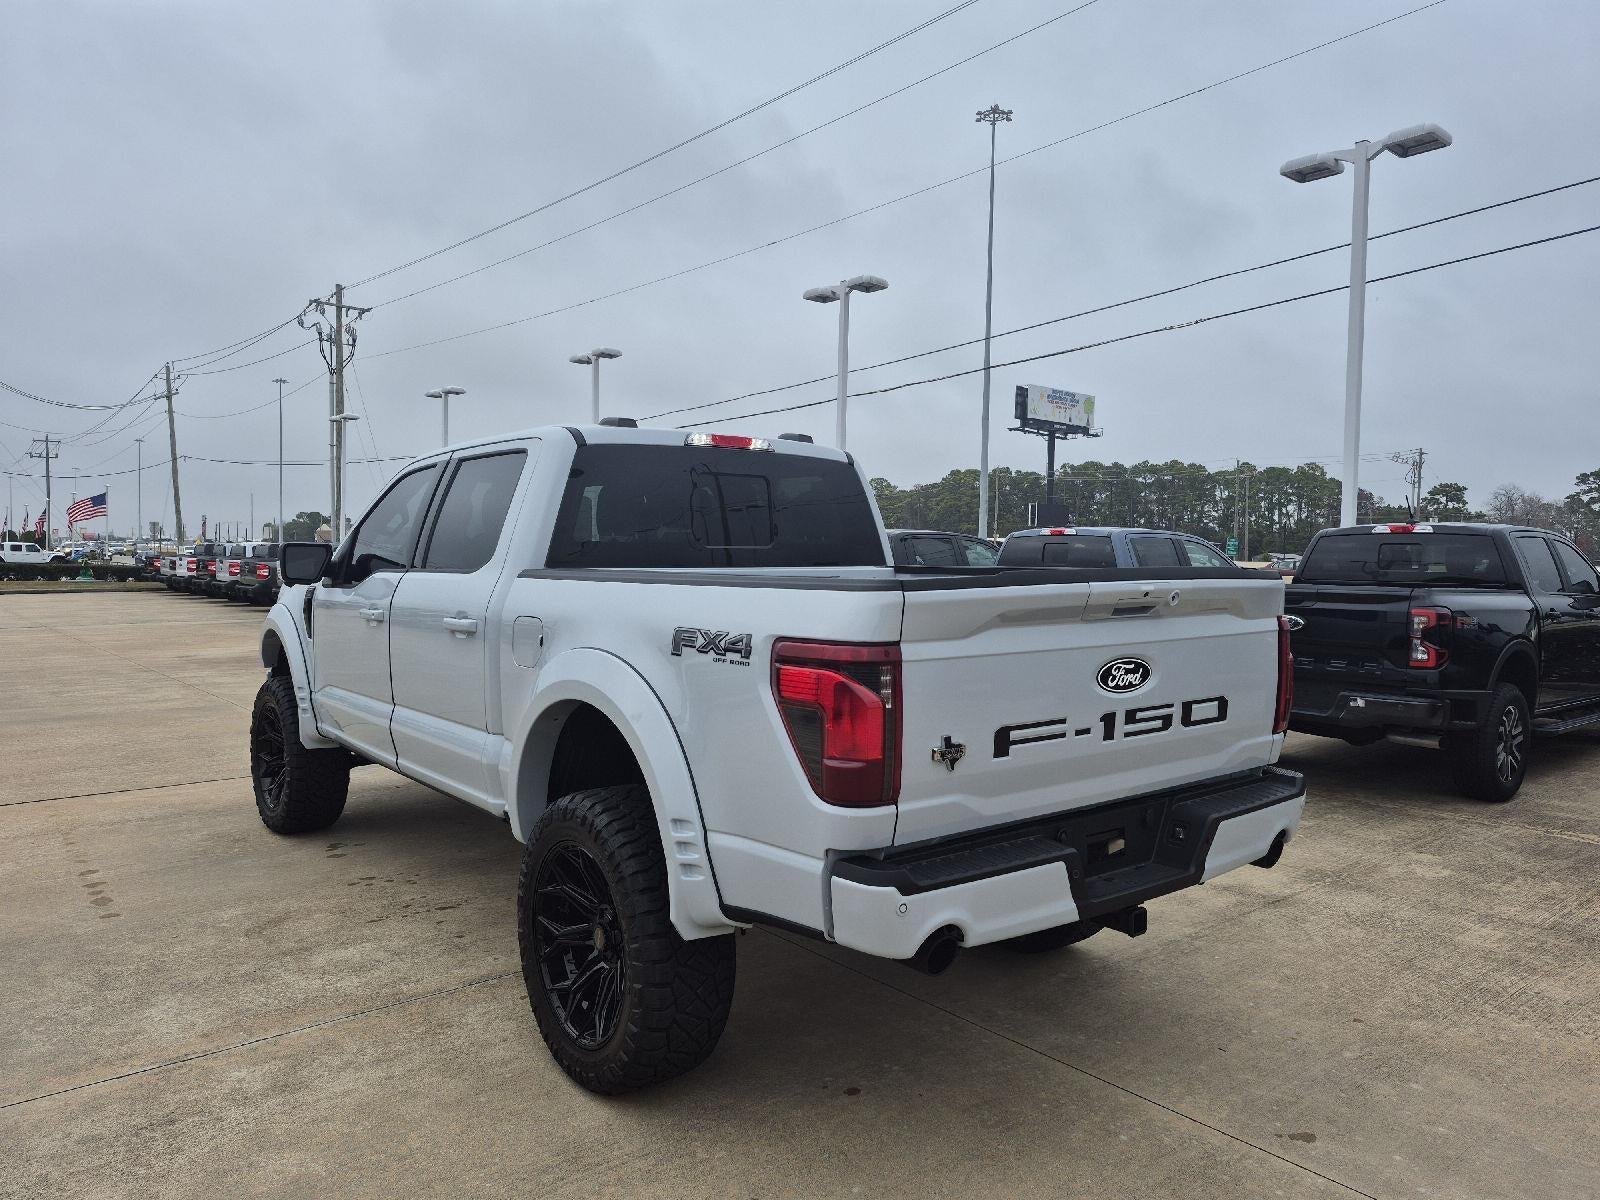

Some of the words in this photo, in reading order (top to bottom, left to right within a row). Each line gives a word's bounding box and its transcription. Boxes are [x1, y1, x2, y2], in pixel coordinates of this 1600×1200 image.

[671, 627, 752, 660] FX4
[729, 659, 750, 667] ROAD
[1107, 663, 1143, 687] Ford
[993, 696, 1229, 759] F-150
